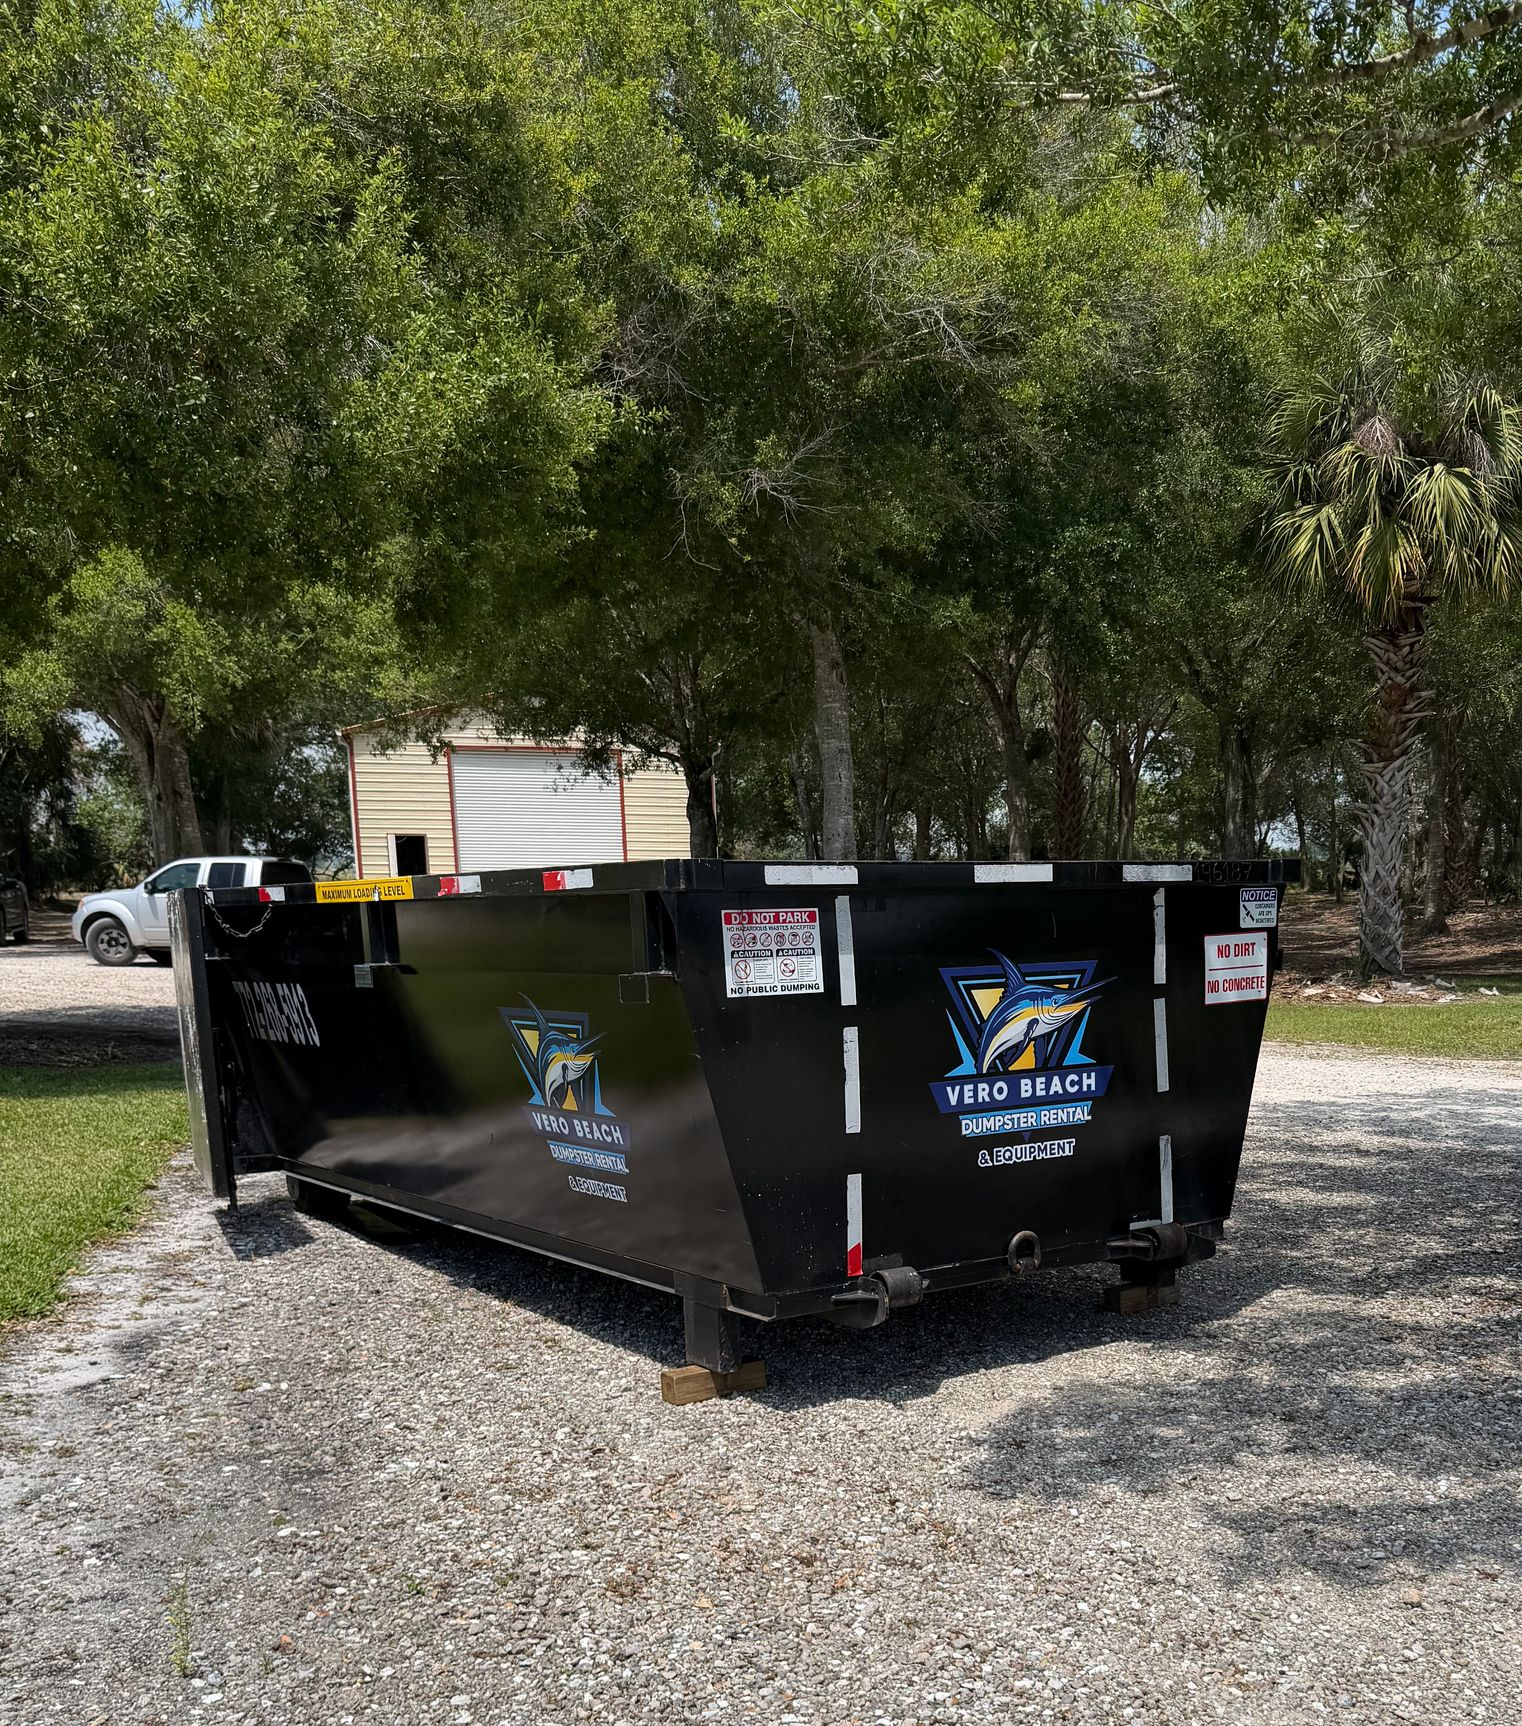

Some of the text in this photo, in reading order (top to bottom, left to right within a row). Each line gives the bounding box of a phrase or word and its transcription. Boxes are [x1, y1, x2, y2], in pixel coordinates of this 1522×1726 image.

[322, 888, 351, 900] MAXIMUM
[383, 885, 405, 896] LEVEL
[1242, 890, 1276, 901] NOTICE
[731, 912, 810, 924] DO NOT PARK
[783, 948, 813, 956] CAUTION
[1217, 942, 1256, 958] NO DIRT
[731, 983, 820, 995] NO PUBLIC DUMPING
[1207, 975, 1265, 994] NO CONCRETE
[232, 981, 320, 1047] 772-268-5913
[946, 1072, 1096, 1106] VERO BEACH
[532, 1112, 624, 1145] VERO BEACH
[961, 1105, 1092, 1136] DUMPSTER RENTAL
[549, 1144, 629, 1173] DUMPSTER RENTAL
[978, 1138, 1076, 1167] & EQUIPMENT
[576, 1177, 627, 1202] EQUIPMENT
